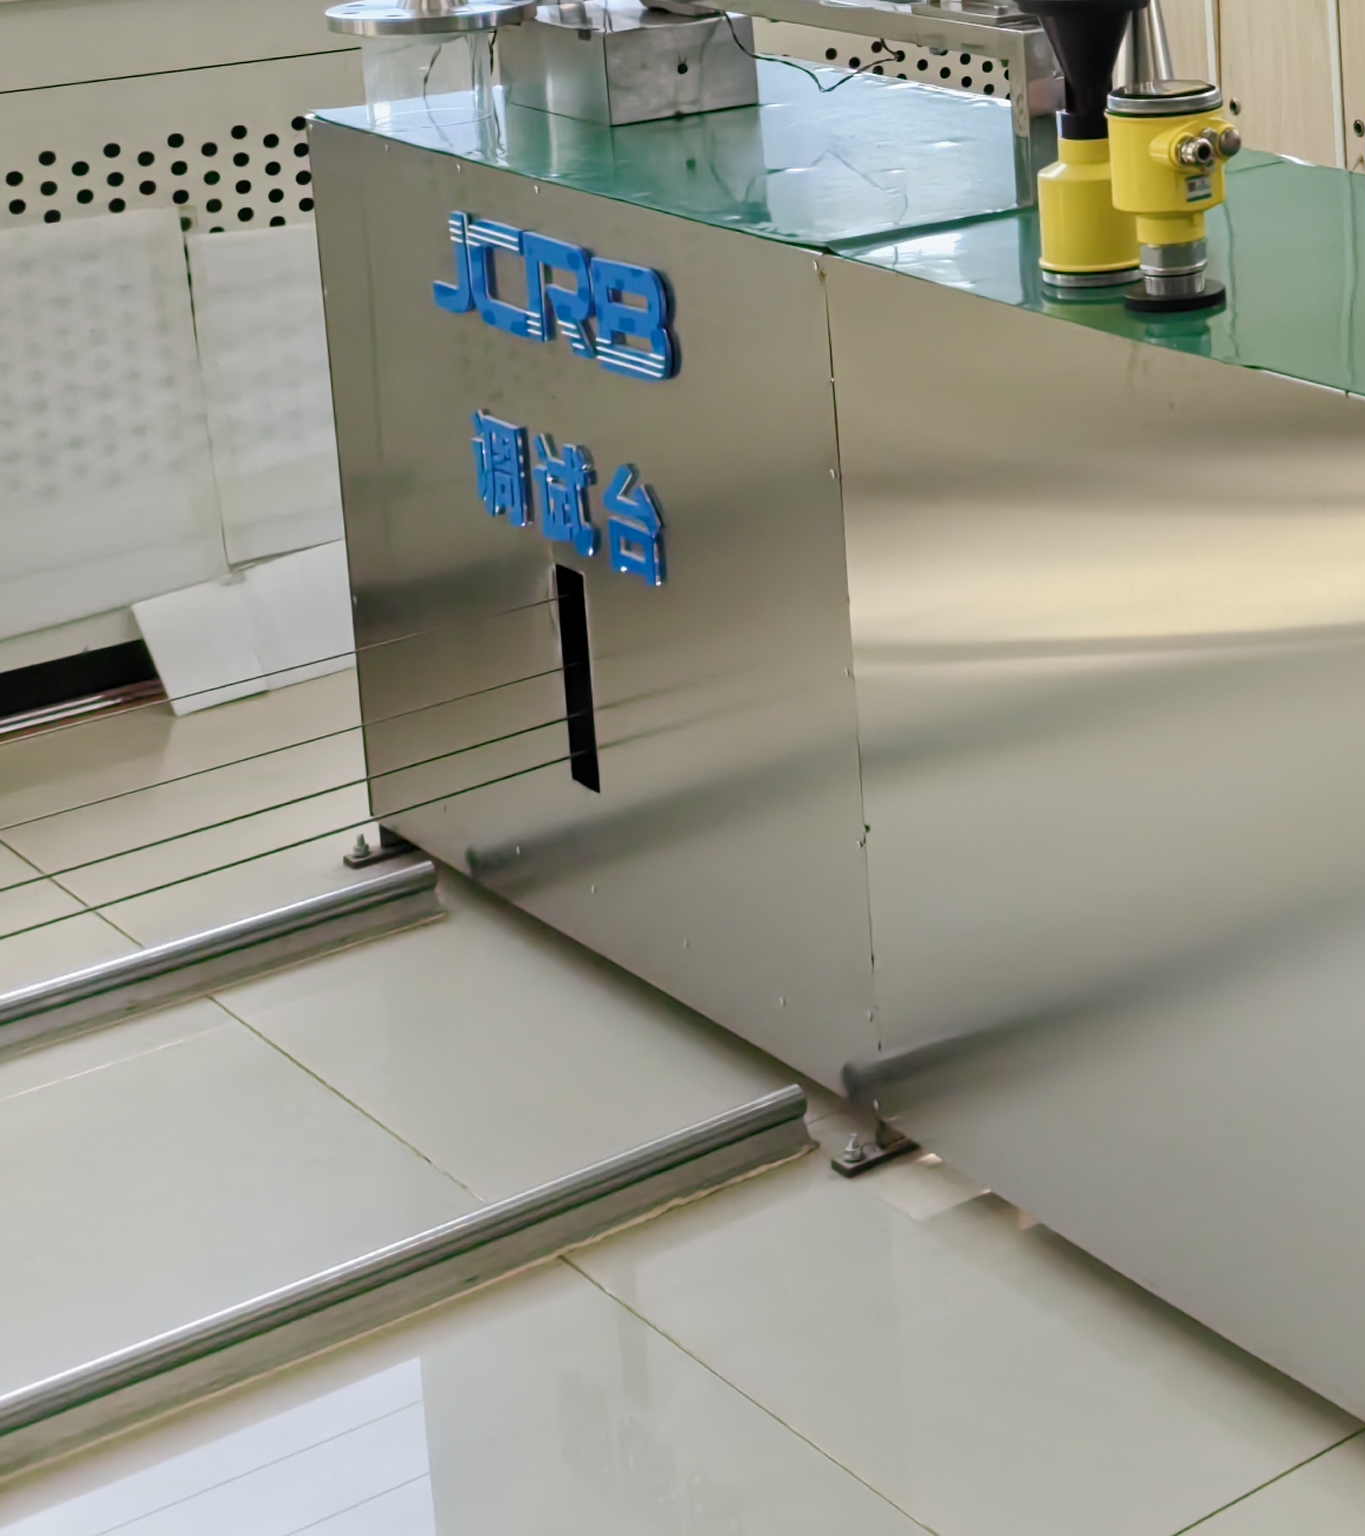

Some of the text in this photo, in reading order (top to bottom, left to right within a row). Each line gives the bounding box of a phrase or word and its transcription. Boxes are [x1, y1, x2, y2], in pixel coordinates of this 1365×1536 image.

[433, 210, 677, 381] JCRB
[471, 408, 664, 587] 调试台
